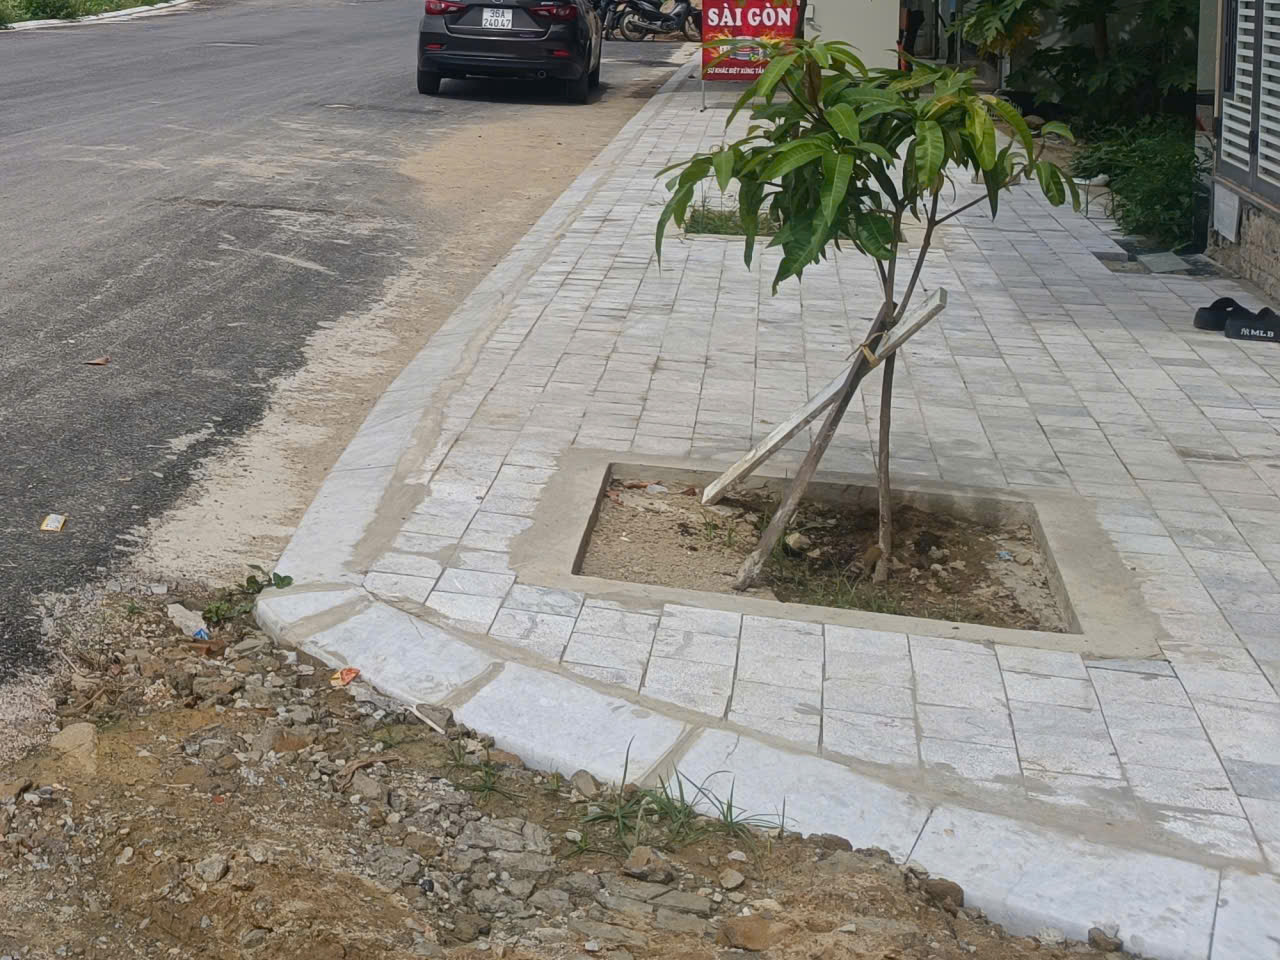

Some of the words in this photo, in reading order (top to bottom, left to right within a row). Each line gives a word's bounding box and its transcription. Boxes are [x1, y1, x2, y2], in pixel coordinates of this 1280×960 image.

[708, 3, 742, 26] SÀI
[748, 3, 792, 26] GÒN
[484, 19, 511, 27] 240.47
[1251, 329, 1274, 337] MLB
